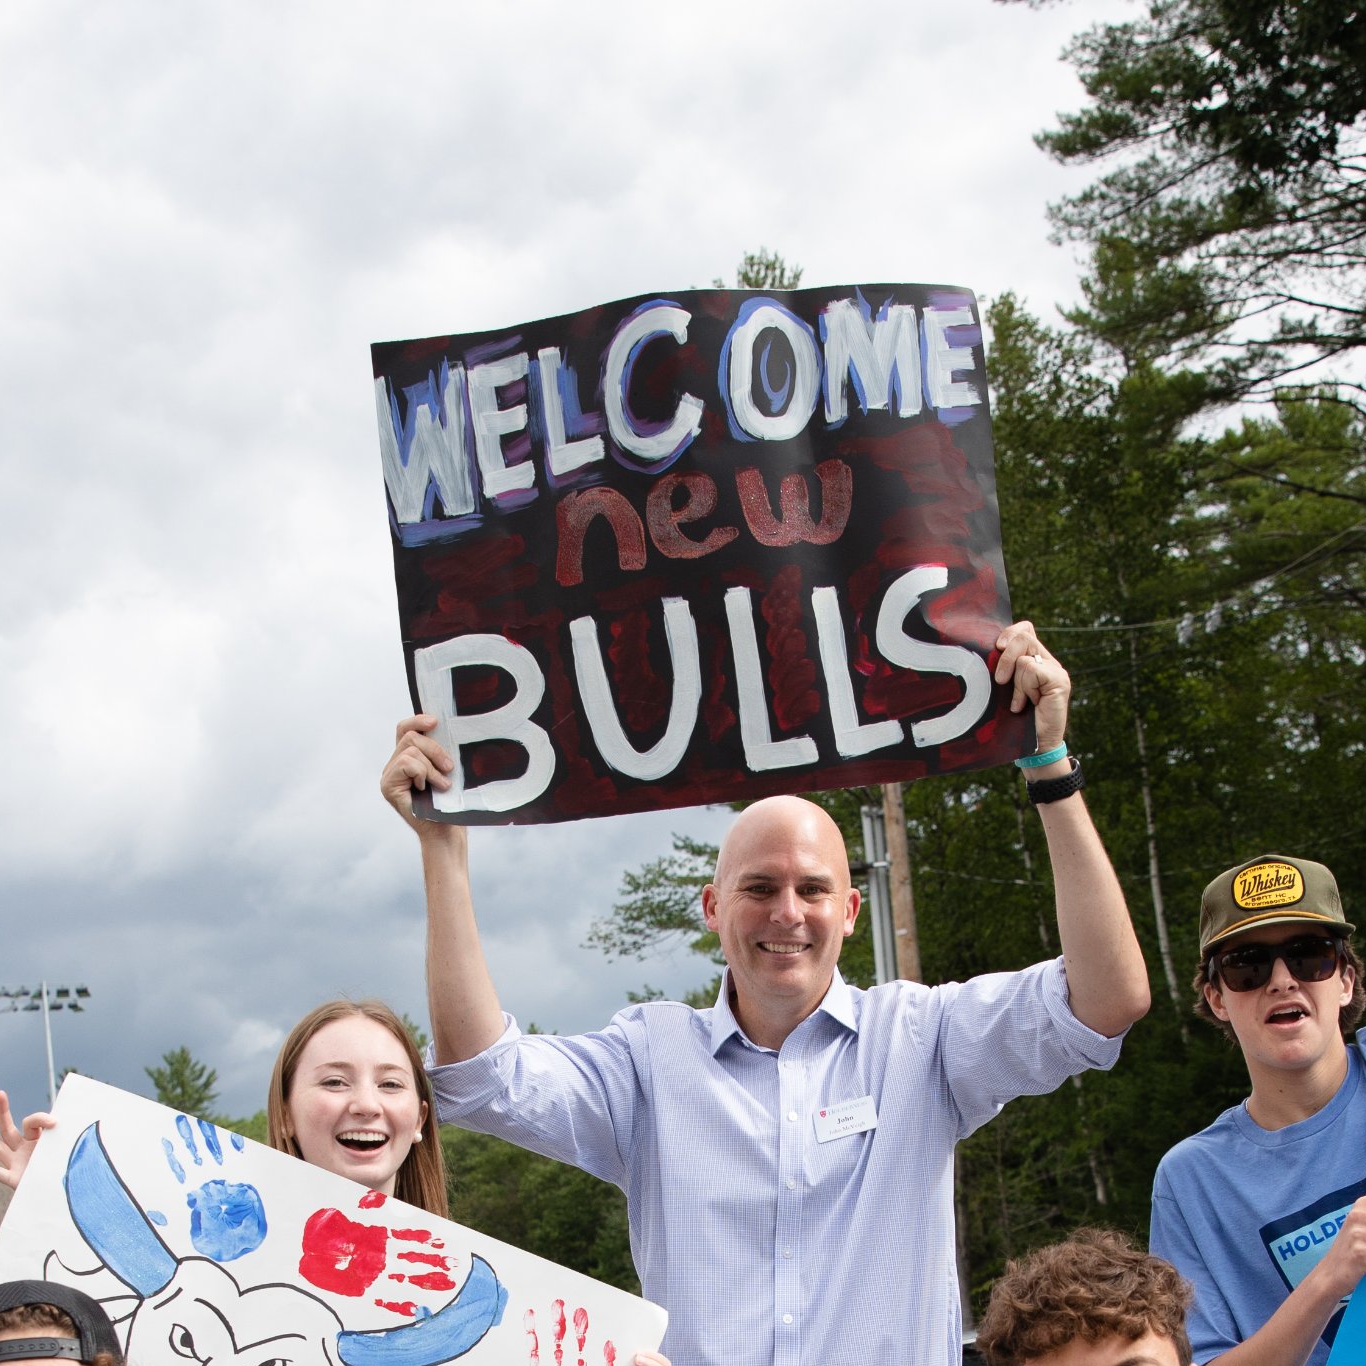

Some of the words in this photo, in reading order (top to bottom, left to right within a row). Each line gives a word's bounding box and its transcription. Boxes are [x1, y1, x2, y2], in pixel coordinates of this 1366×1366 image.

[374, 292, 983, 537] WELCOME
[554, 459, 854, 588] new
[414, 565, 992, 813] BULLS
[1239, 869, 1296, 900] Whiskey
[837, 1115, 854, 1125] John
[1277, 1213, 1349, 1261] HOLDE
